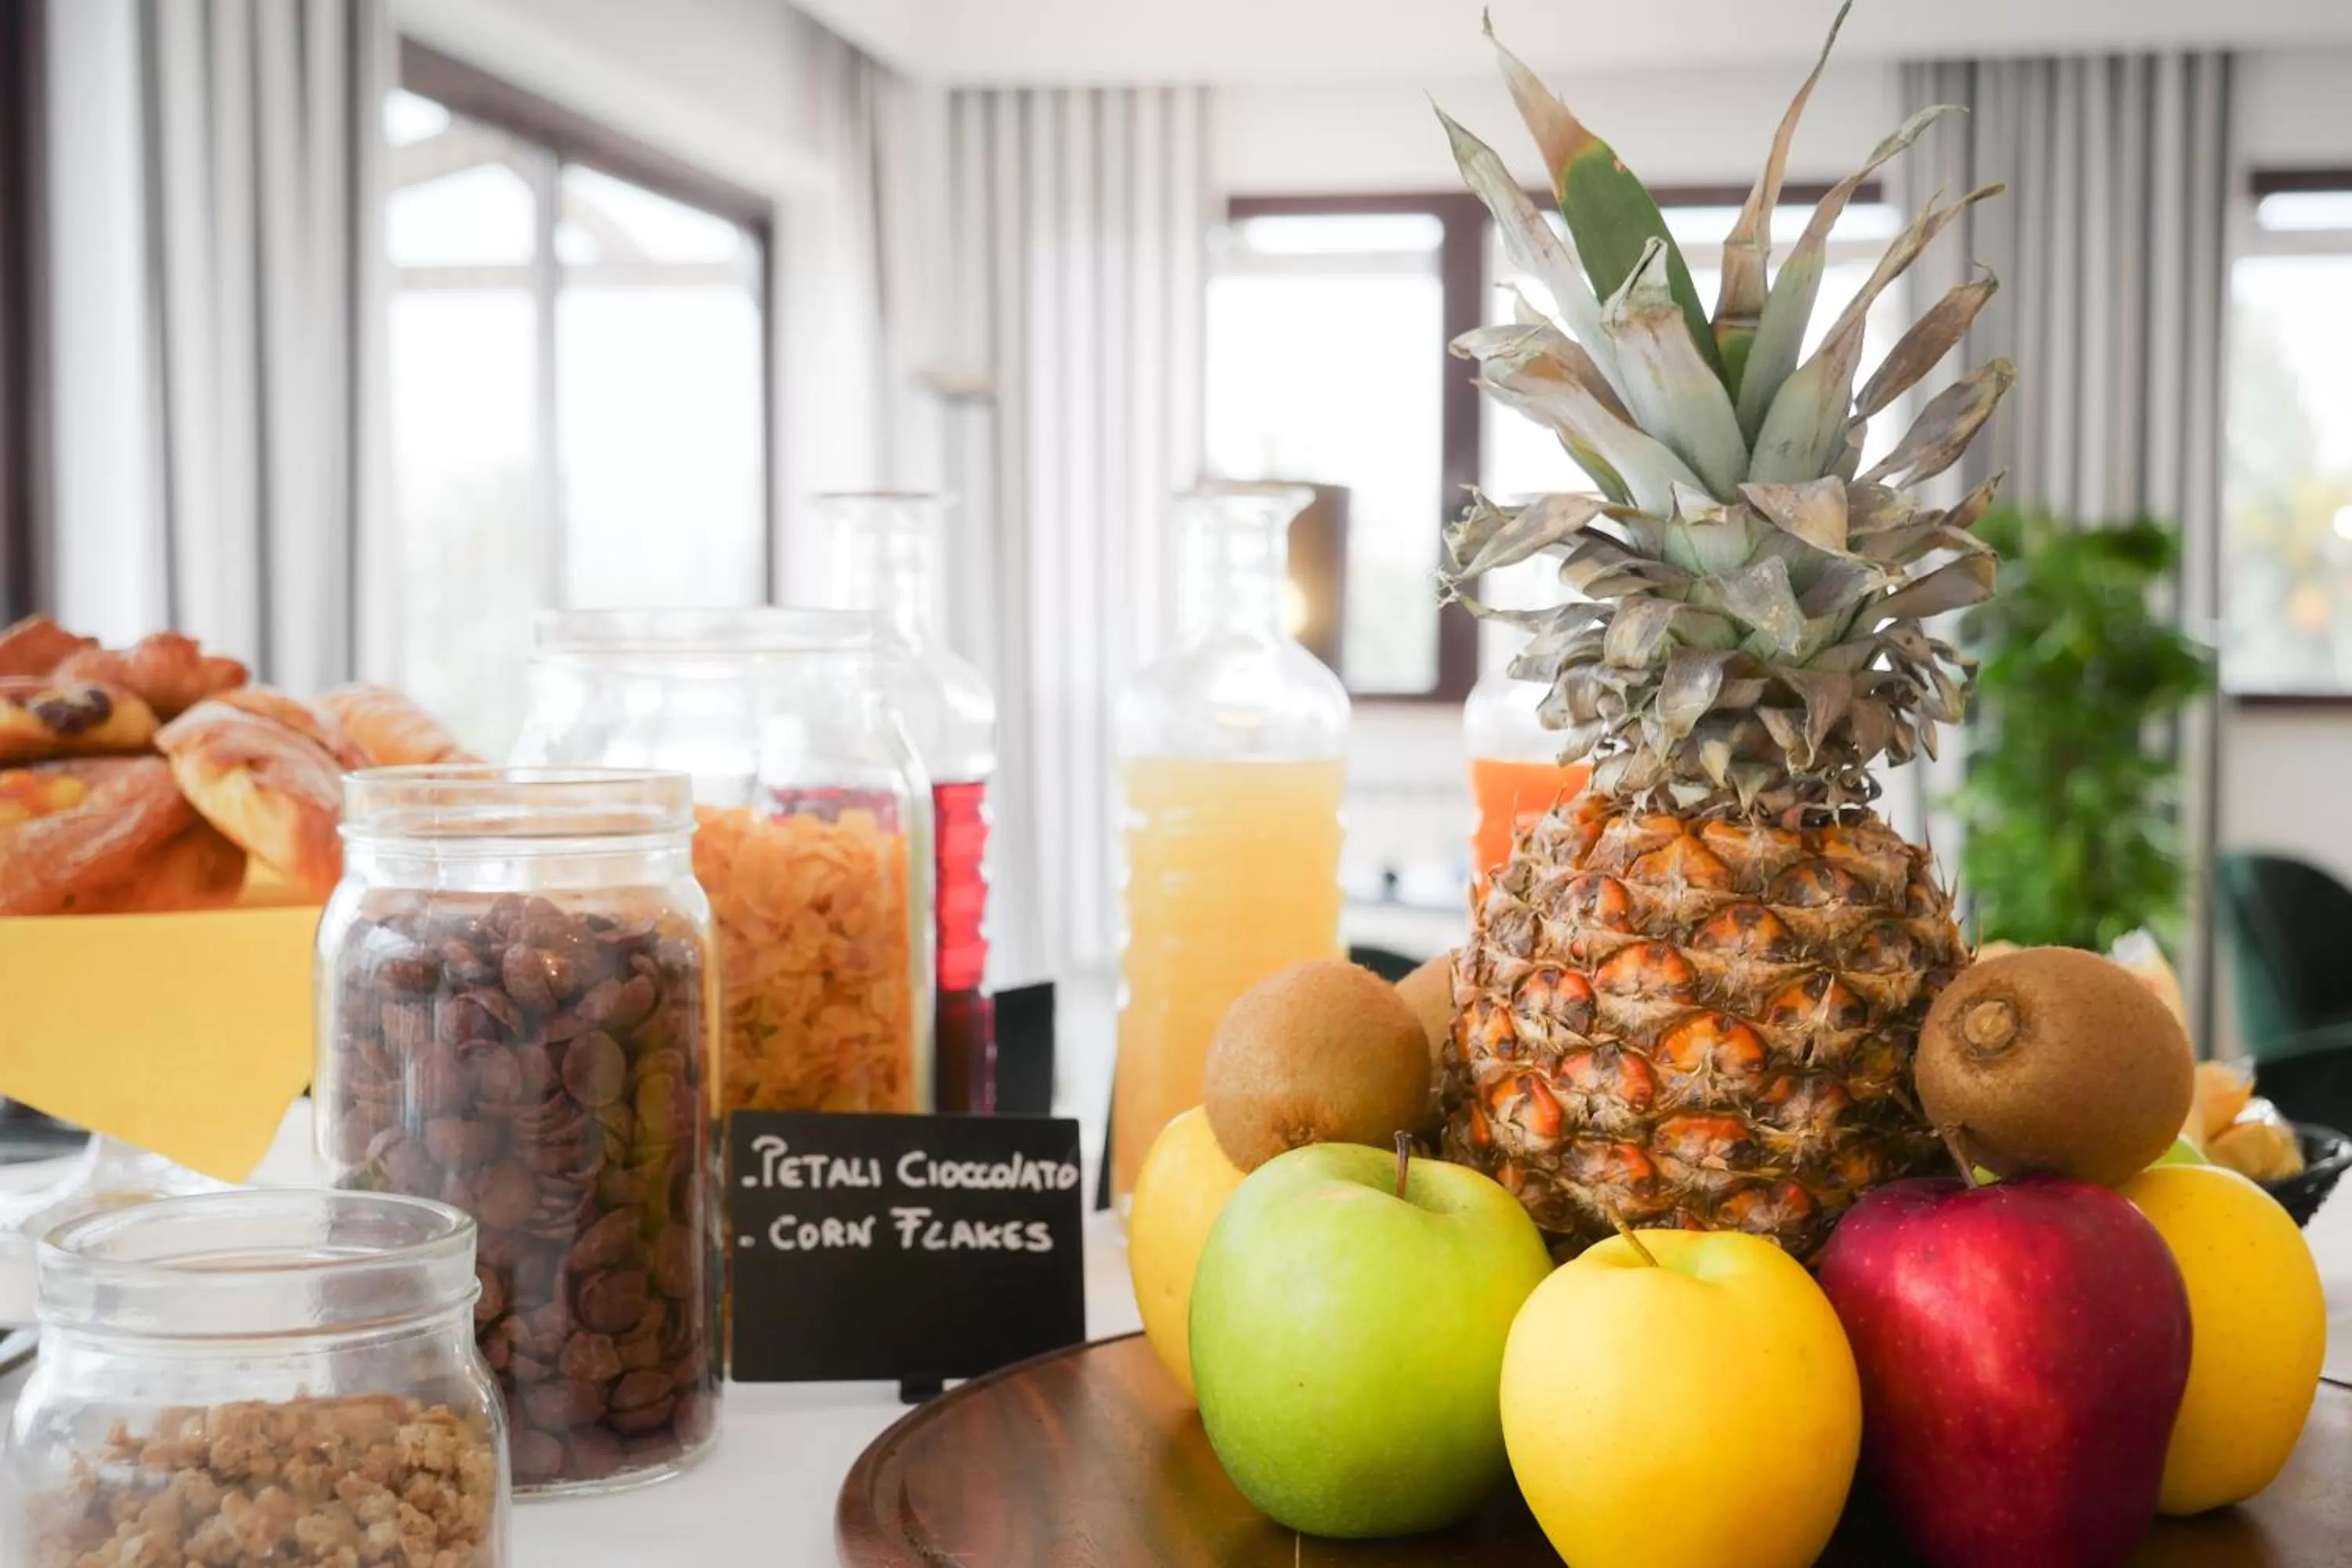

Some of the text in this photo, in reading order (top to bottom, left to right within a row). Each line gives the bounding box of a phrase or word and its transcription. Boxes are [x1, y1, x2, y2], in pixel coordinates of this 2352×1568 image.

[751, 1134, 882, 1189] PETALI
[769, 1207, 1054, 1252] CORN FLAKES
